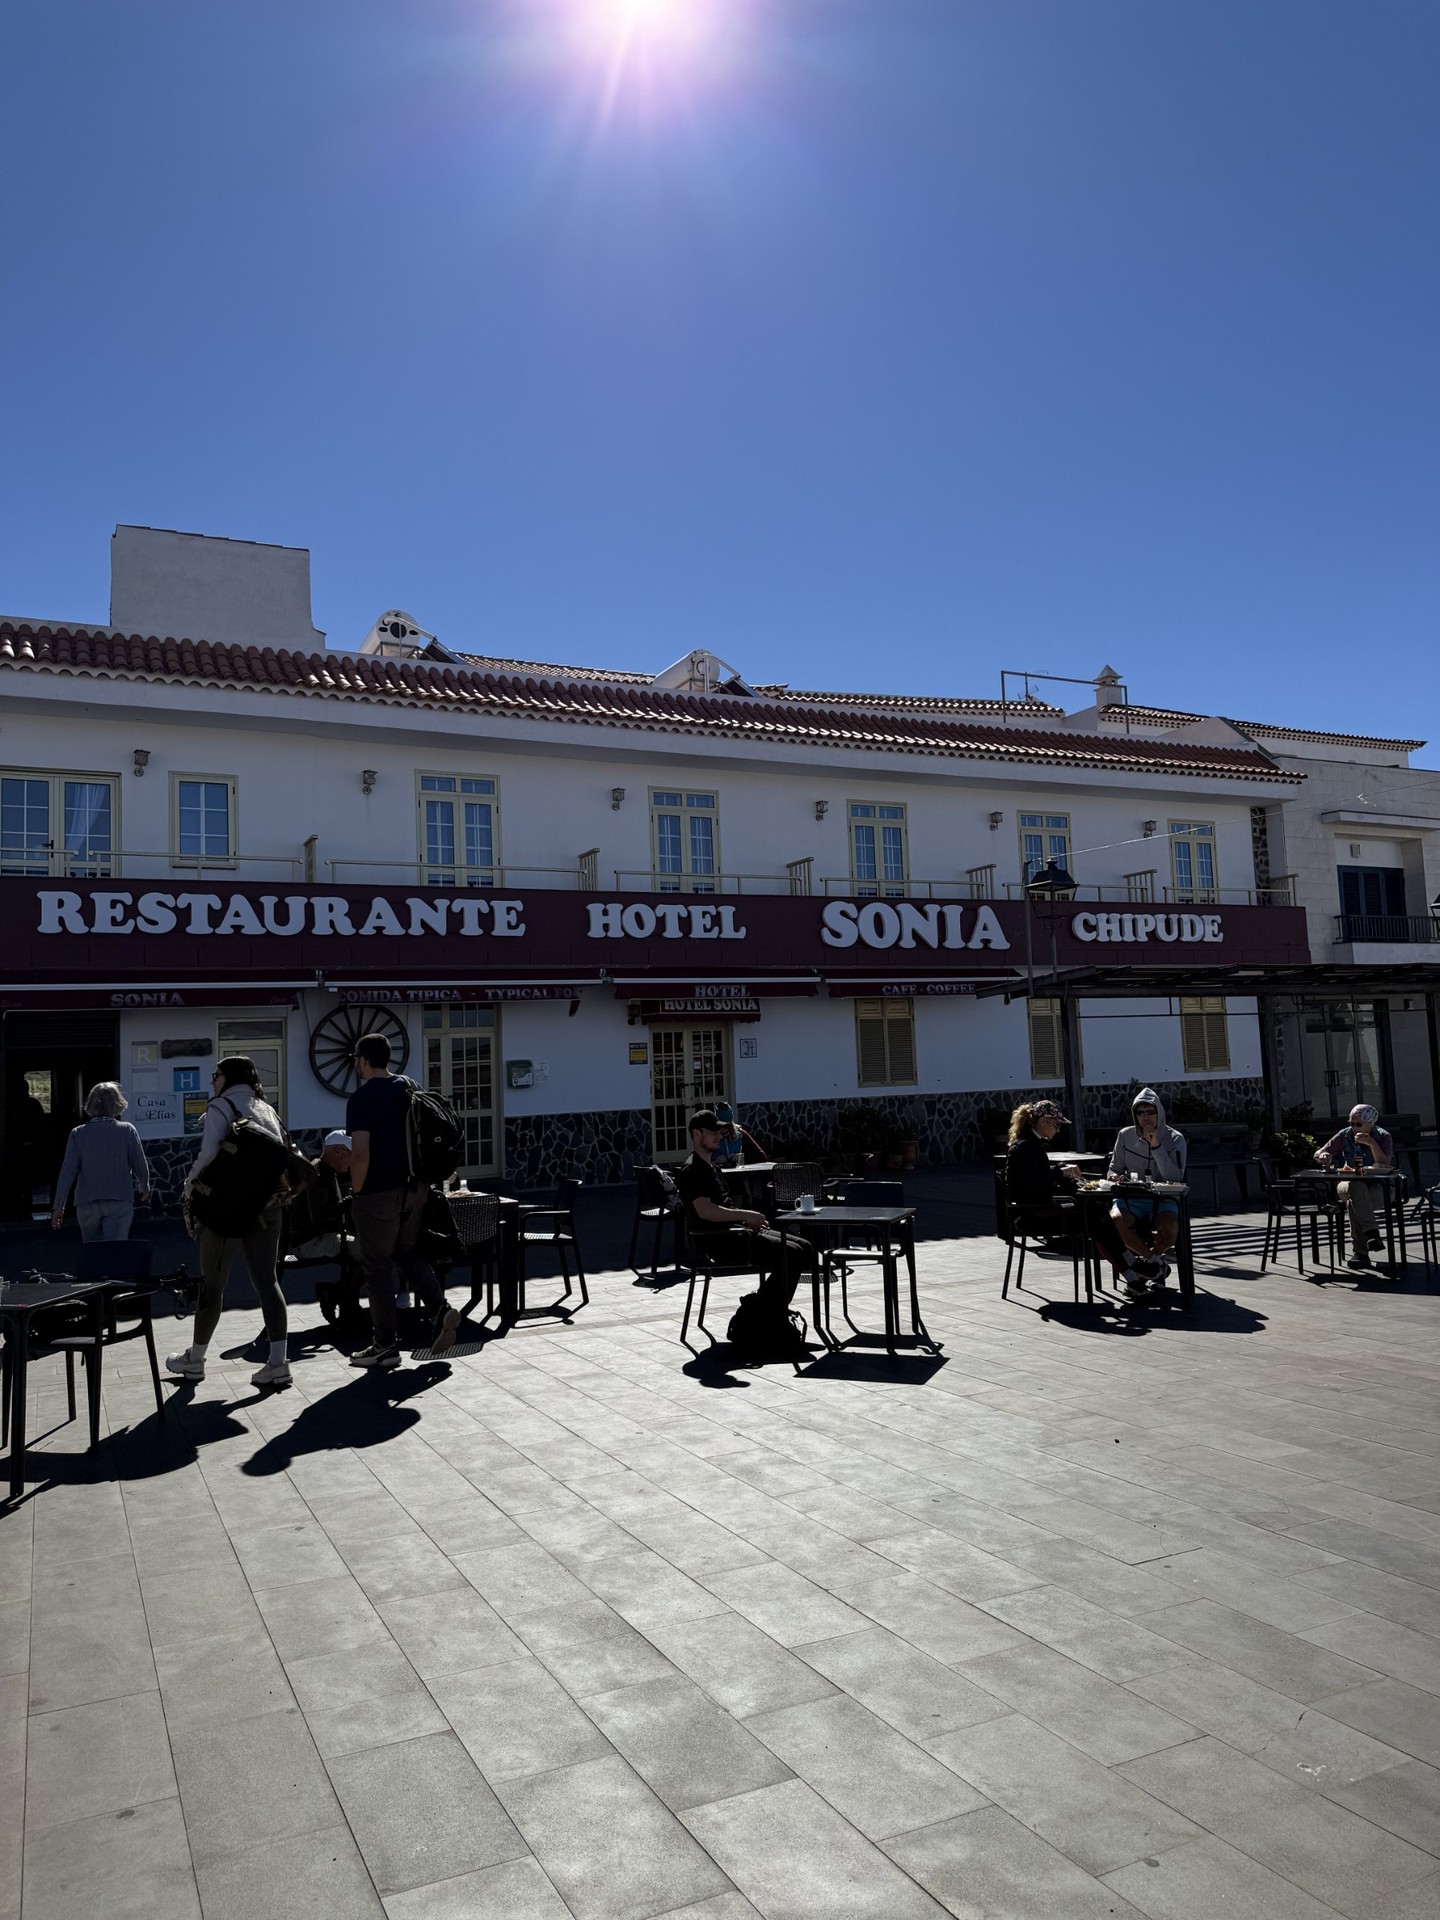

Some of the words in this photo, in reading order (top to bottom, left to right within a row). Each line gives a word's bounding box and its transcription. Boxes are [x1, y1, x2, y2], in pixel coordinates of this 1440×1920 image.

[36, 890, 526, 936] RESTAURANTE
[587, 903, 747, 940] HOTEL
[820, 900, 1011, 950] SONIA
[1072, 912, 1224, 943] CHIPUDE
[340, 989, 403, 1003] COMIDA
[407, 989, 462, 1002] TIPICA
[485, 988, 551, 1001] TYPICAL
[694, 985, 751, 998] HOTEL
[881, 984, 918, 996] CAFE
[926, 983, 976, 994] COFFEE
[110, 991, 186, 1007] SONIA
[664, 998, 711, 1010] HOTEL
[713, 998, 759, 1010] SONIA
[137, 1047, 151, 1064] R
[180, 1073, 194, 1088] H
[137, 1095, 166, 1108] Casa
